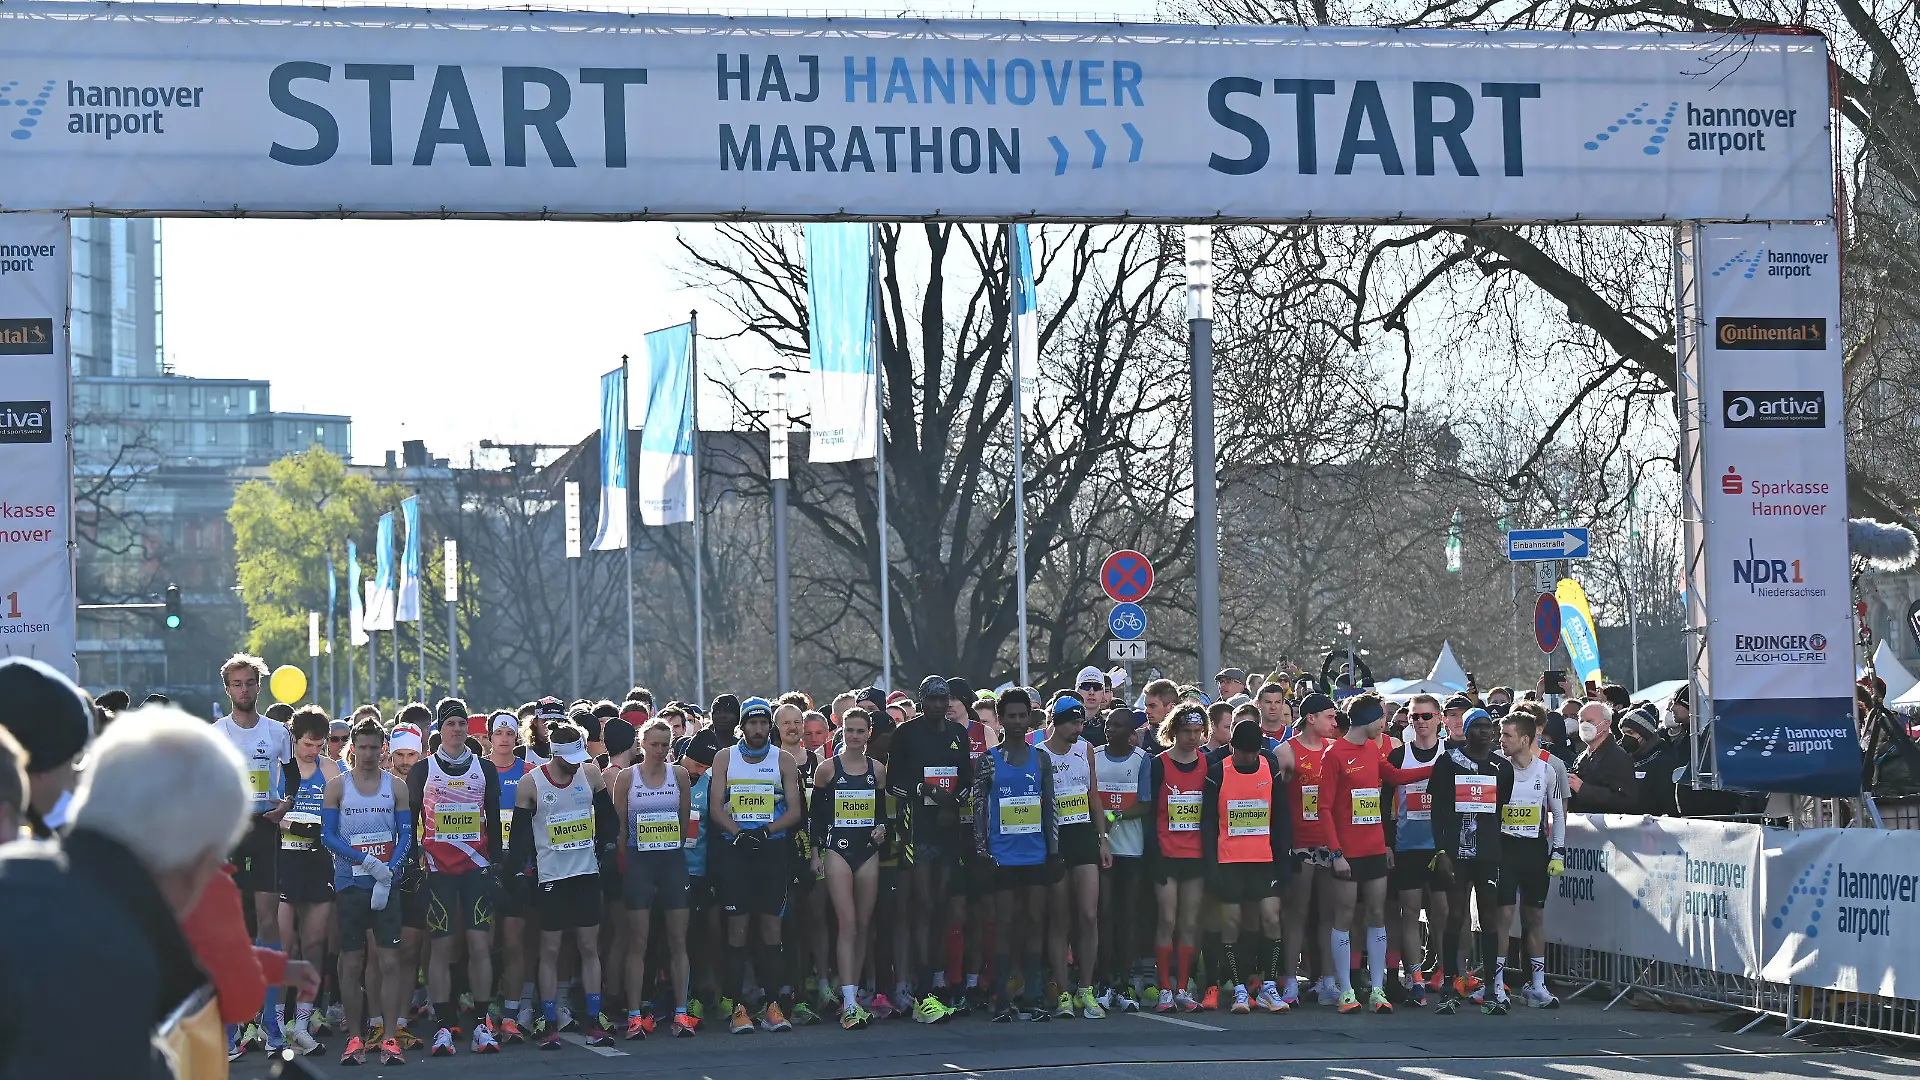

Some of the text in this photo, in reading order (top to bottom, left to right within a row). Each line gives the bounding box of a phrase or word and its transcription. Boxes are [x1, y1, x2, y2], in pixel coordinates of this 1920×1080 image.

[717, 53, 1144, 107] HAJ HANNOVER
[67, 80, 203, 109] hannover
[268, 61, 648, 168] START
[1687, 102, 1797, 129] hannover
[67, 110, 164, 140] airport
[1208, 76, 1540, 177] START
[719, 123, 1020, 174] MARATHON
[1687, 129, 1766, 155] airport
[1768, 249, 1828, 264] hannover
[1768, 264, 1811, 279] airport
[1720, 324, 1807, 344] Continental
[1759, 397, 1819, 415] artiva
[1752, 480, 1829, 497] Sparkasse
[1752, 502, 1827, 516] Hannover
[1513, 540, 1565, 550] Einbahnstraße
[1758, 587, 1826, 597] Niedersachsen
[1735, 634, 1809, 651] ERDINGER
[1735, 652, 1827, 663] ALKOHOLFREI
[1785, 727, 1847, 740] hannover
[1788, 738, 1833, 755] airport
[939, 778, 950, 788] 99
[1470, 785, 1483, 796] 94
[739, 795, 765, 806] Frank
[842, 801, 869, 811] Rabea
[1110, 793, 1122, 804] 95
[1421, 794, 1432, 804] 89
[1176, 804, 1199, 815] 2543
[1507, 808, 1532, 818] 2302
[443, 814, 473, 825] Moritz
[553, 823, 588, 836] Marcus
[639, 824, 679, 834] Domenika
[361, 844, 386, 856] PACE
[1685, 852, 1746, 889] hannover
[1838, 862, 1919, 903] hannover
[1559, 875, 1595, 906] airport
[1685, 889, 1729, 920] airport
[1838, 904, 1891, 942] airport
